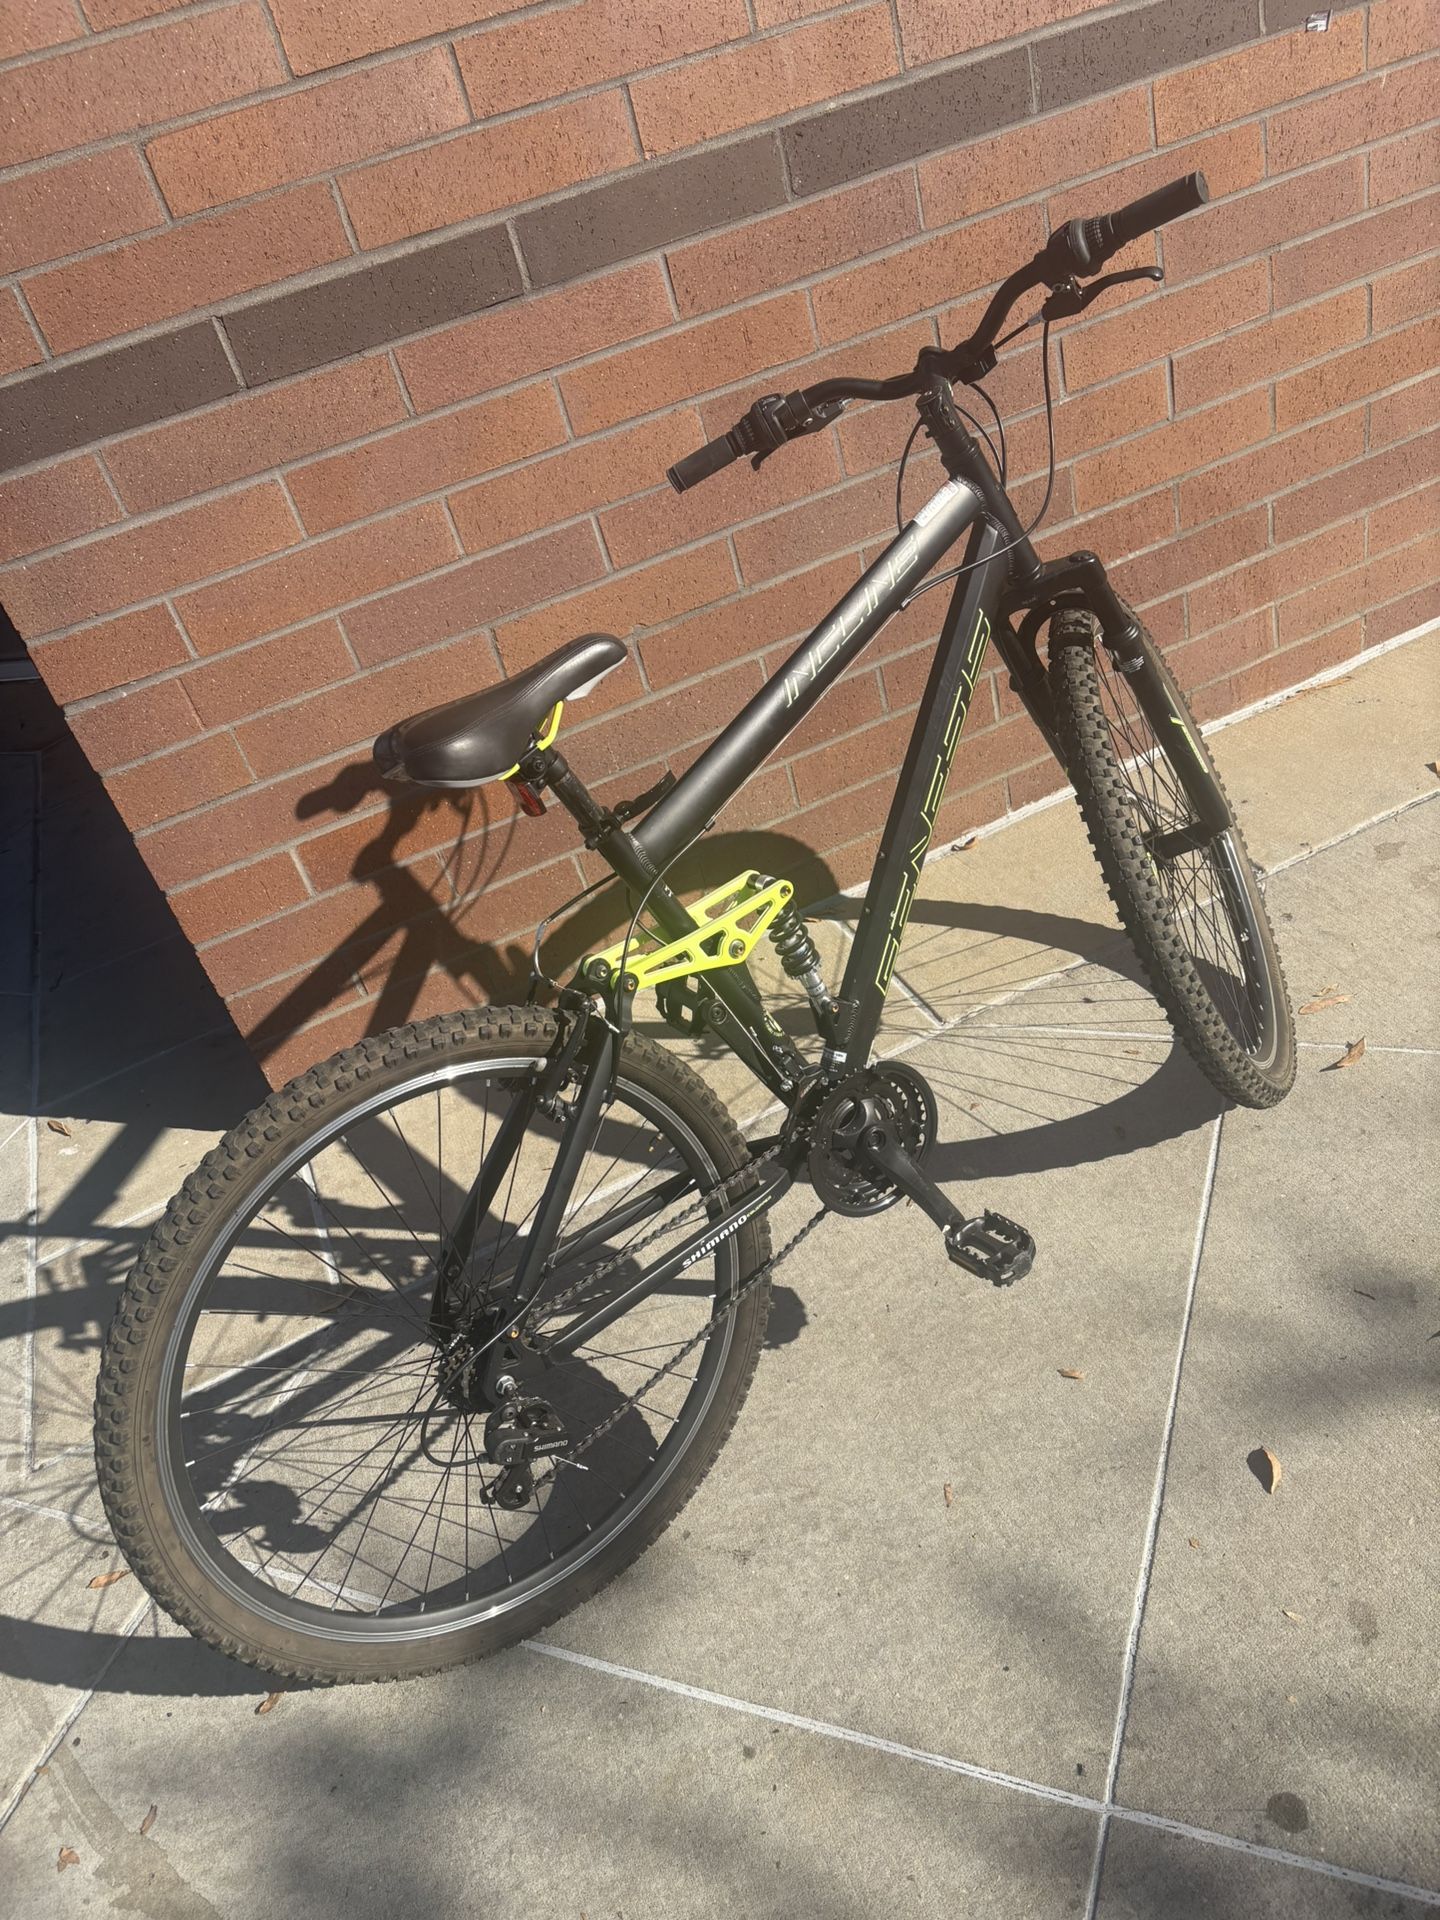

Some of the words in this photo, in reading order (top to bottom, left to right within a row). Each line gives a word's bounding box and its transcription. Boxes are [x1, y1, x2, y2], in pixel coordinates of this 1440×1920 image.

[783, 534, 920, 708] INCLINE
[875, 608, 991, 998] GENESIS
[682, 1214, 748, 1269] SHIMANO
[533, 1439, 569, 1452] SHIMANO
